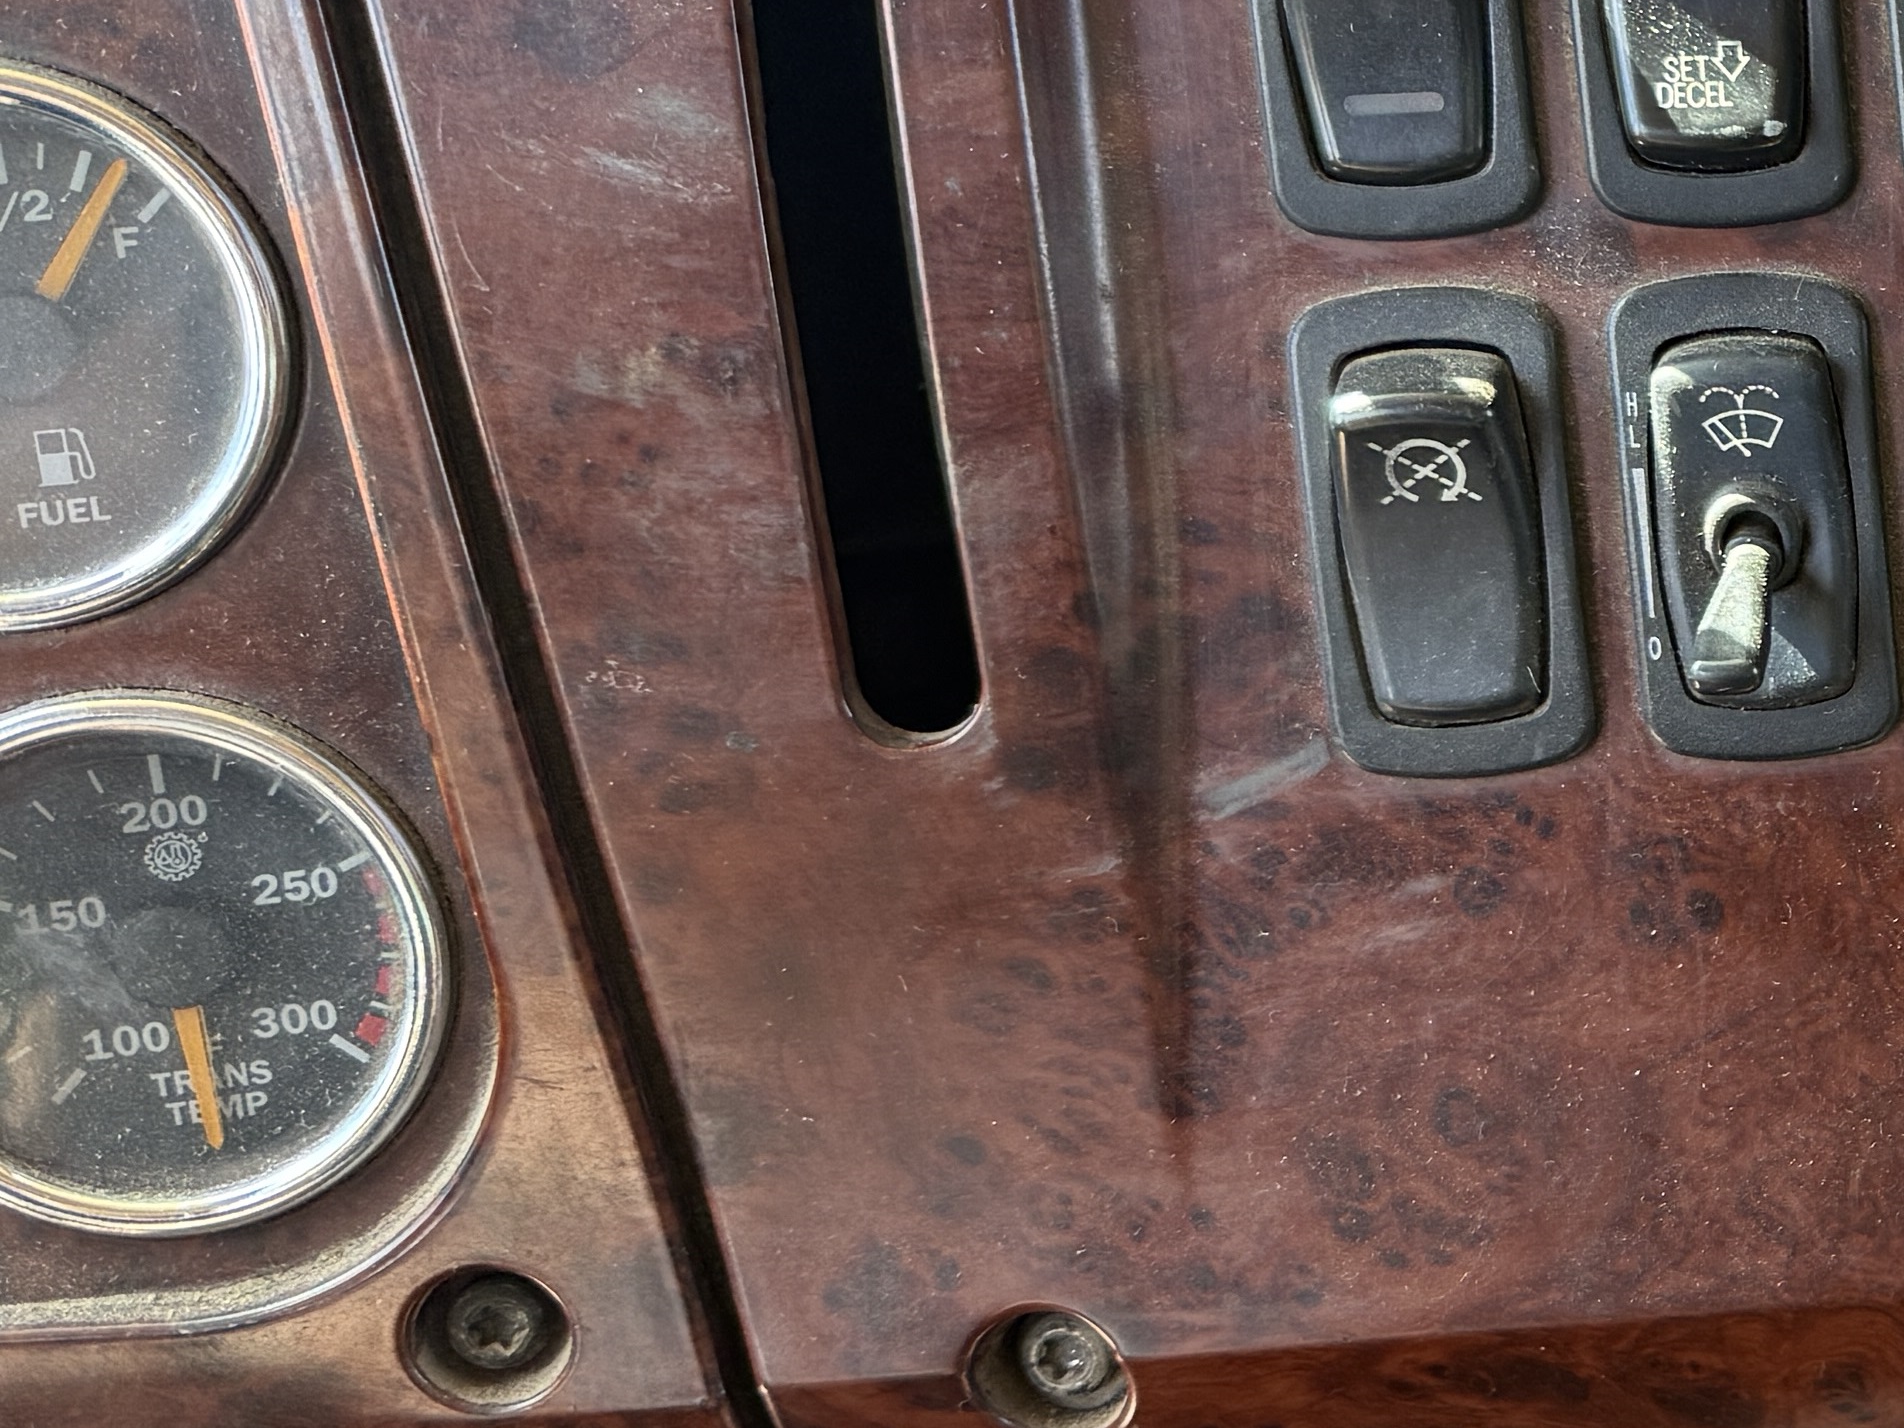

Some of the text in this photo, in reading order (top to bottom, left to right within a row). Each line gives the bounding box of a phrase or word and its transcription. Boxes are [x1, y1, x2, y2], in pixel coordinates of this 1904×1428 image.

[1662, 53, 1709, 85] SET
[1655, 78, 1734, 112] DECEL
[113, 226, 139, 258] F
[1626, 392, 1638, 417] H
[1629, 424, 1641, 448] L
[17, 495, 112, 529] FUEL
[120, 794, 208, 835] 200
[250, 866, 337, 907] 250
[14, 896, 106, 932] 150
[250, 998, 337, 1040] 300
[82, 1021, 170, 1062] 100
